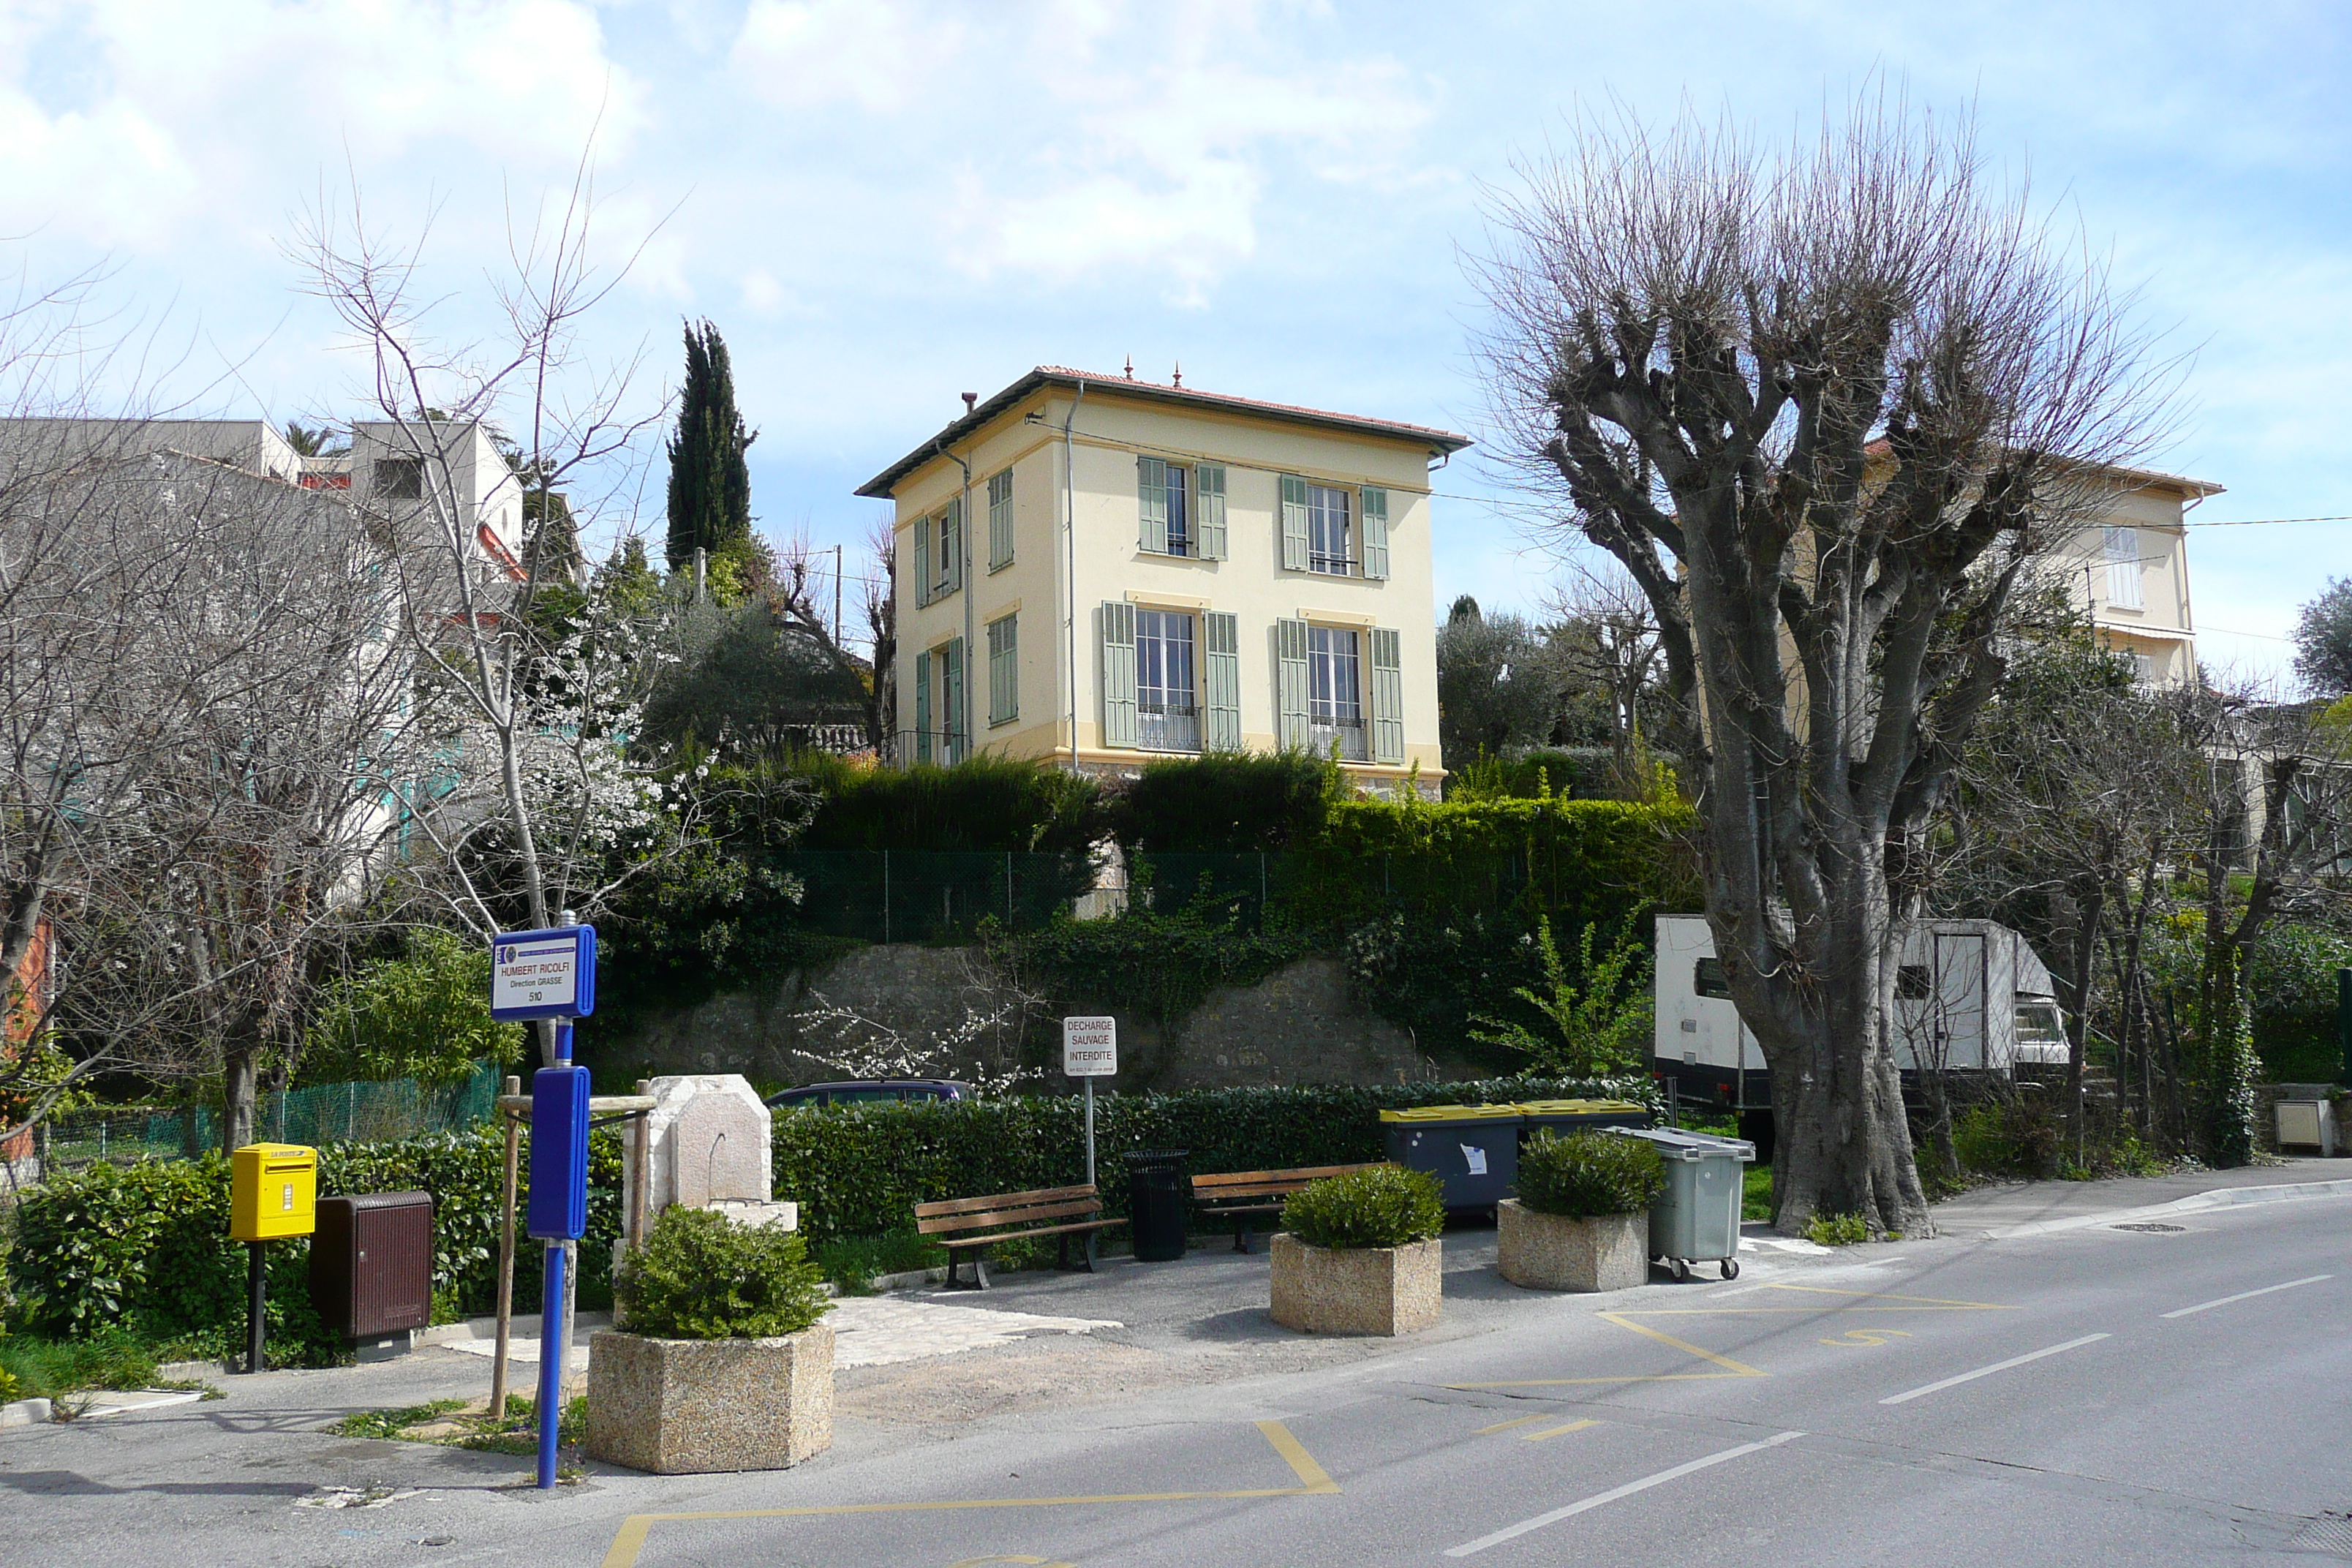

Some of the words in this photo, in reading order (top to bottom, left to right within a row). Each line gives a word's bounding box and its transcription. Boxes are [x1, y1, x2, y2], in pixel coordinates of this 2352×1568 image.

[501, 965, 538, 976] HUMBERT
[540, 962, 570, 973] RICOLFI
[510, 979, 536, 988] Direction
[538, 976, 562, 985] GRASSE
[529, 991, 542, 1002] 510
[1068, 1021, 1112, 1030] DECHARGE
[1072, 1035, 1109, 1044] SAUVAGE
[1070, 1051, 1112, 1060] INTERDITE
